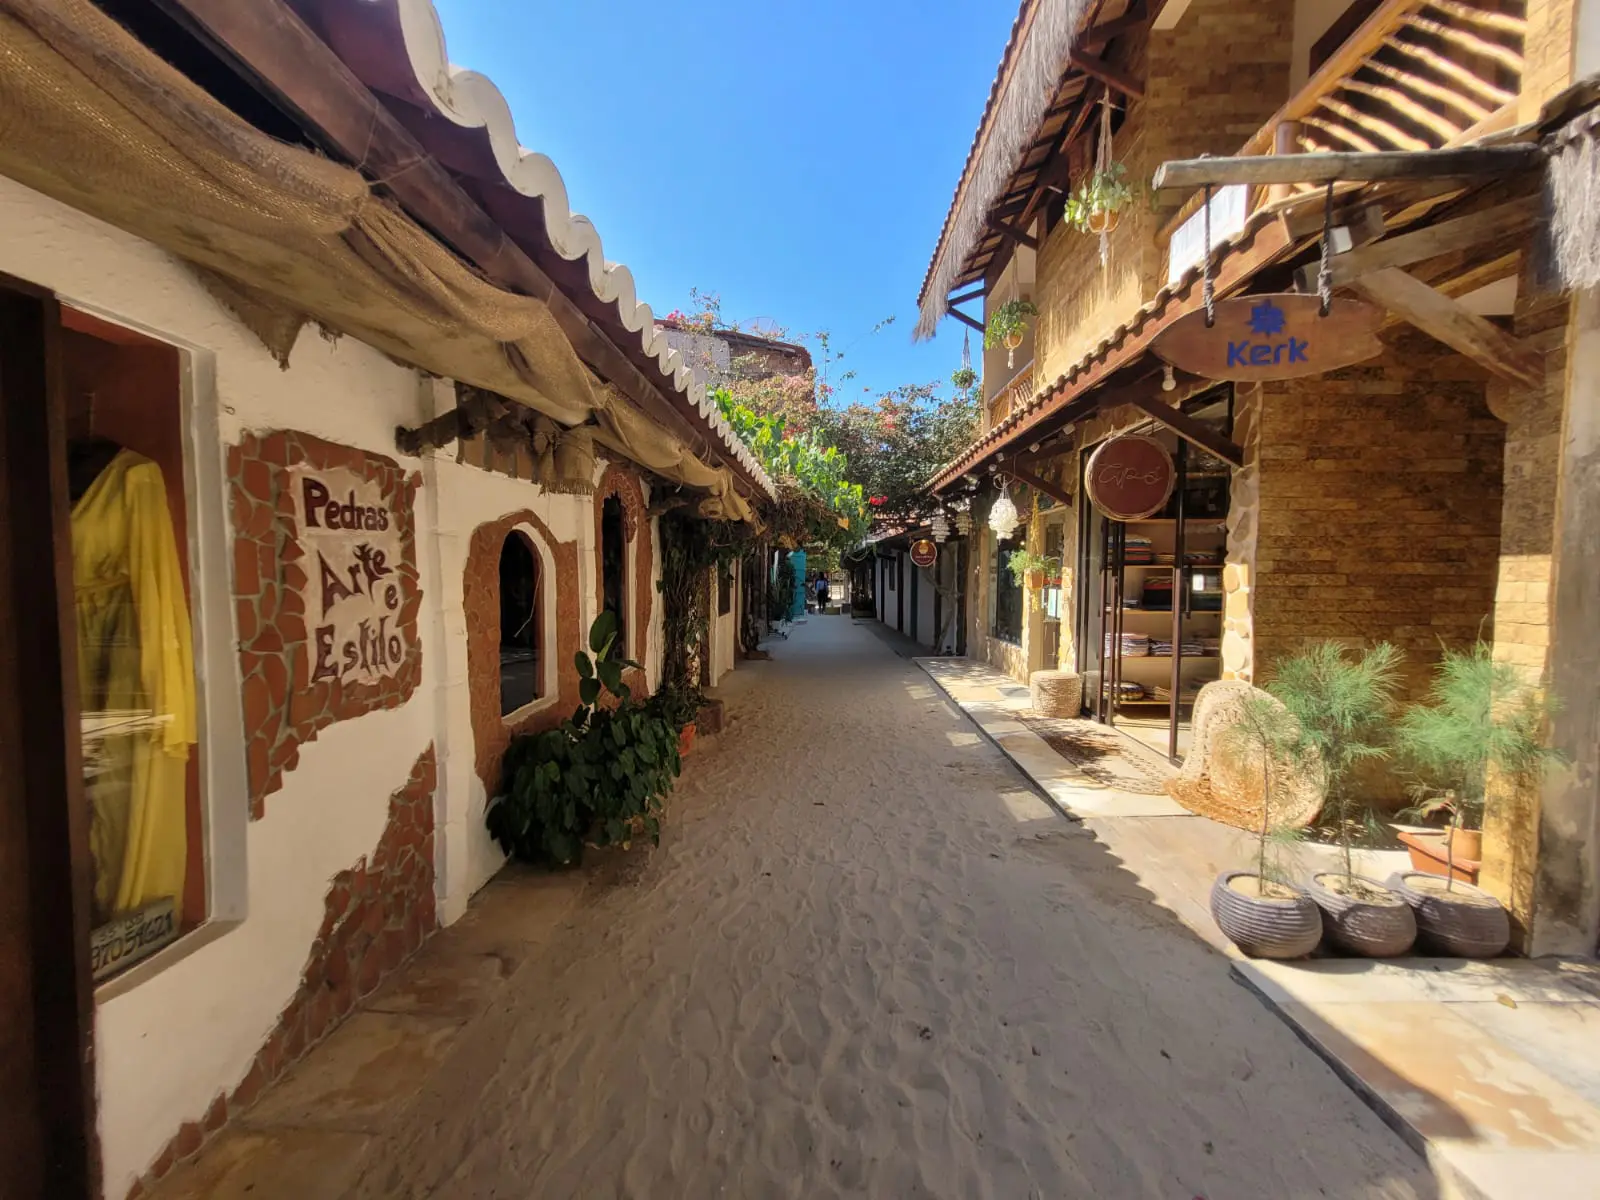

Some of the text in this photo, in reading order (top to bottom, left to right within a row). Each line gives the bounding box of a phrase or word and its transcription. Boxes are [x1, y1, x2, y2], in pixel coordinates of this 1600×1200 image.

[1227, 335, 1309, 368] Kerk
[302, 476, 389, 530] Pedras
[316, 543, 393, 620] Arte
[384, 583, 399, 611] e
[311, 615, 402, 684] Estilo
